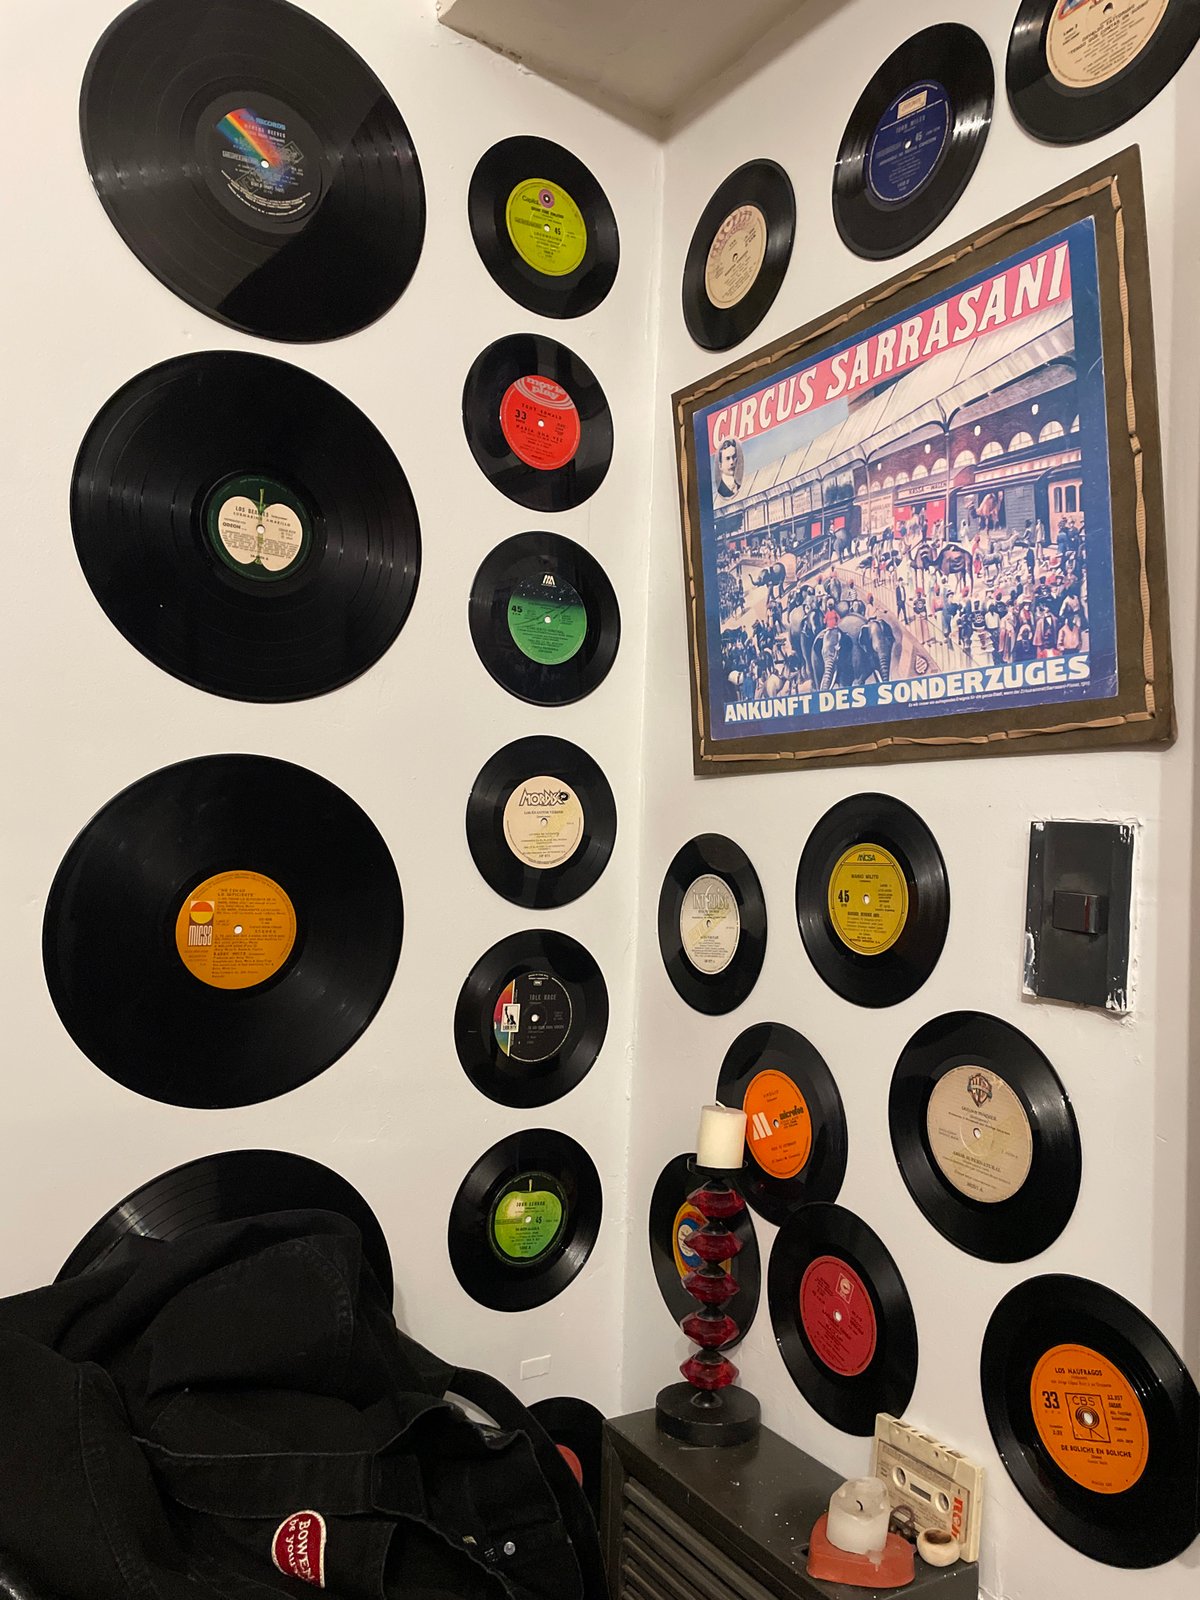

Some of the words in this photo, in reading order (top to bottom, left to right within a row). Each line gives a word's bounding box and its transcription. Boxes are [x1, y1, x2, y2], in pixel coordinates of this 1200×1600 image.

[712, 368, 817, 451] CIRCUS
[825, 242, 1070, 402] SARRASANI
[514, 408, 527, 421] 33
[247, 508, 270, 518] BEAES
[511, 604, 523, 613] 45
[724, 694, 811, 723] ANKUNFT
[818, 687, 867, 712] DES
[876, 655, 1091, 705] SONDERZUGES
[838, 889, 850, 903] 45
[1068, 1368, 1103, 1377] NAUFRAGOS
[1041, 1390, 1061, 1410] 33
[1071, 1395, 1096, 1407] CBS
[1070, 1444, 1095, 1454] BOLICHE
[1106, 1449, 1132, 1458] BOLICHE
